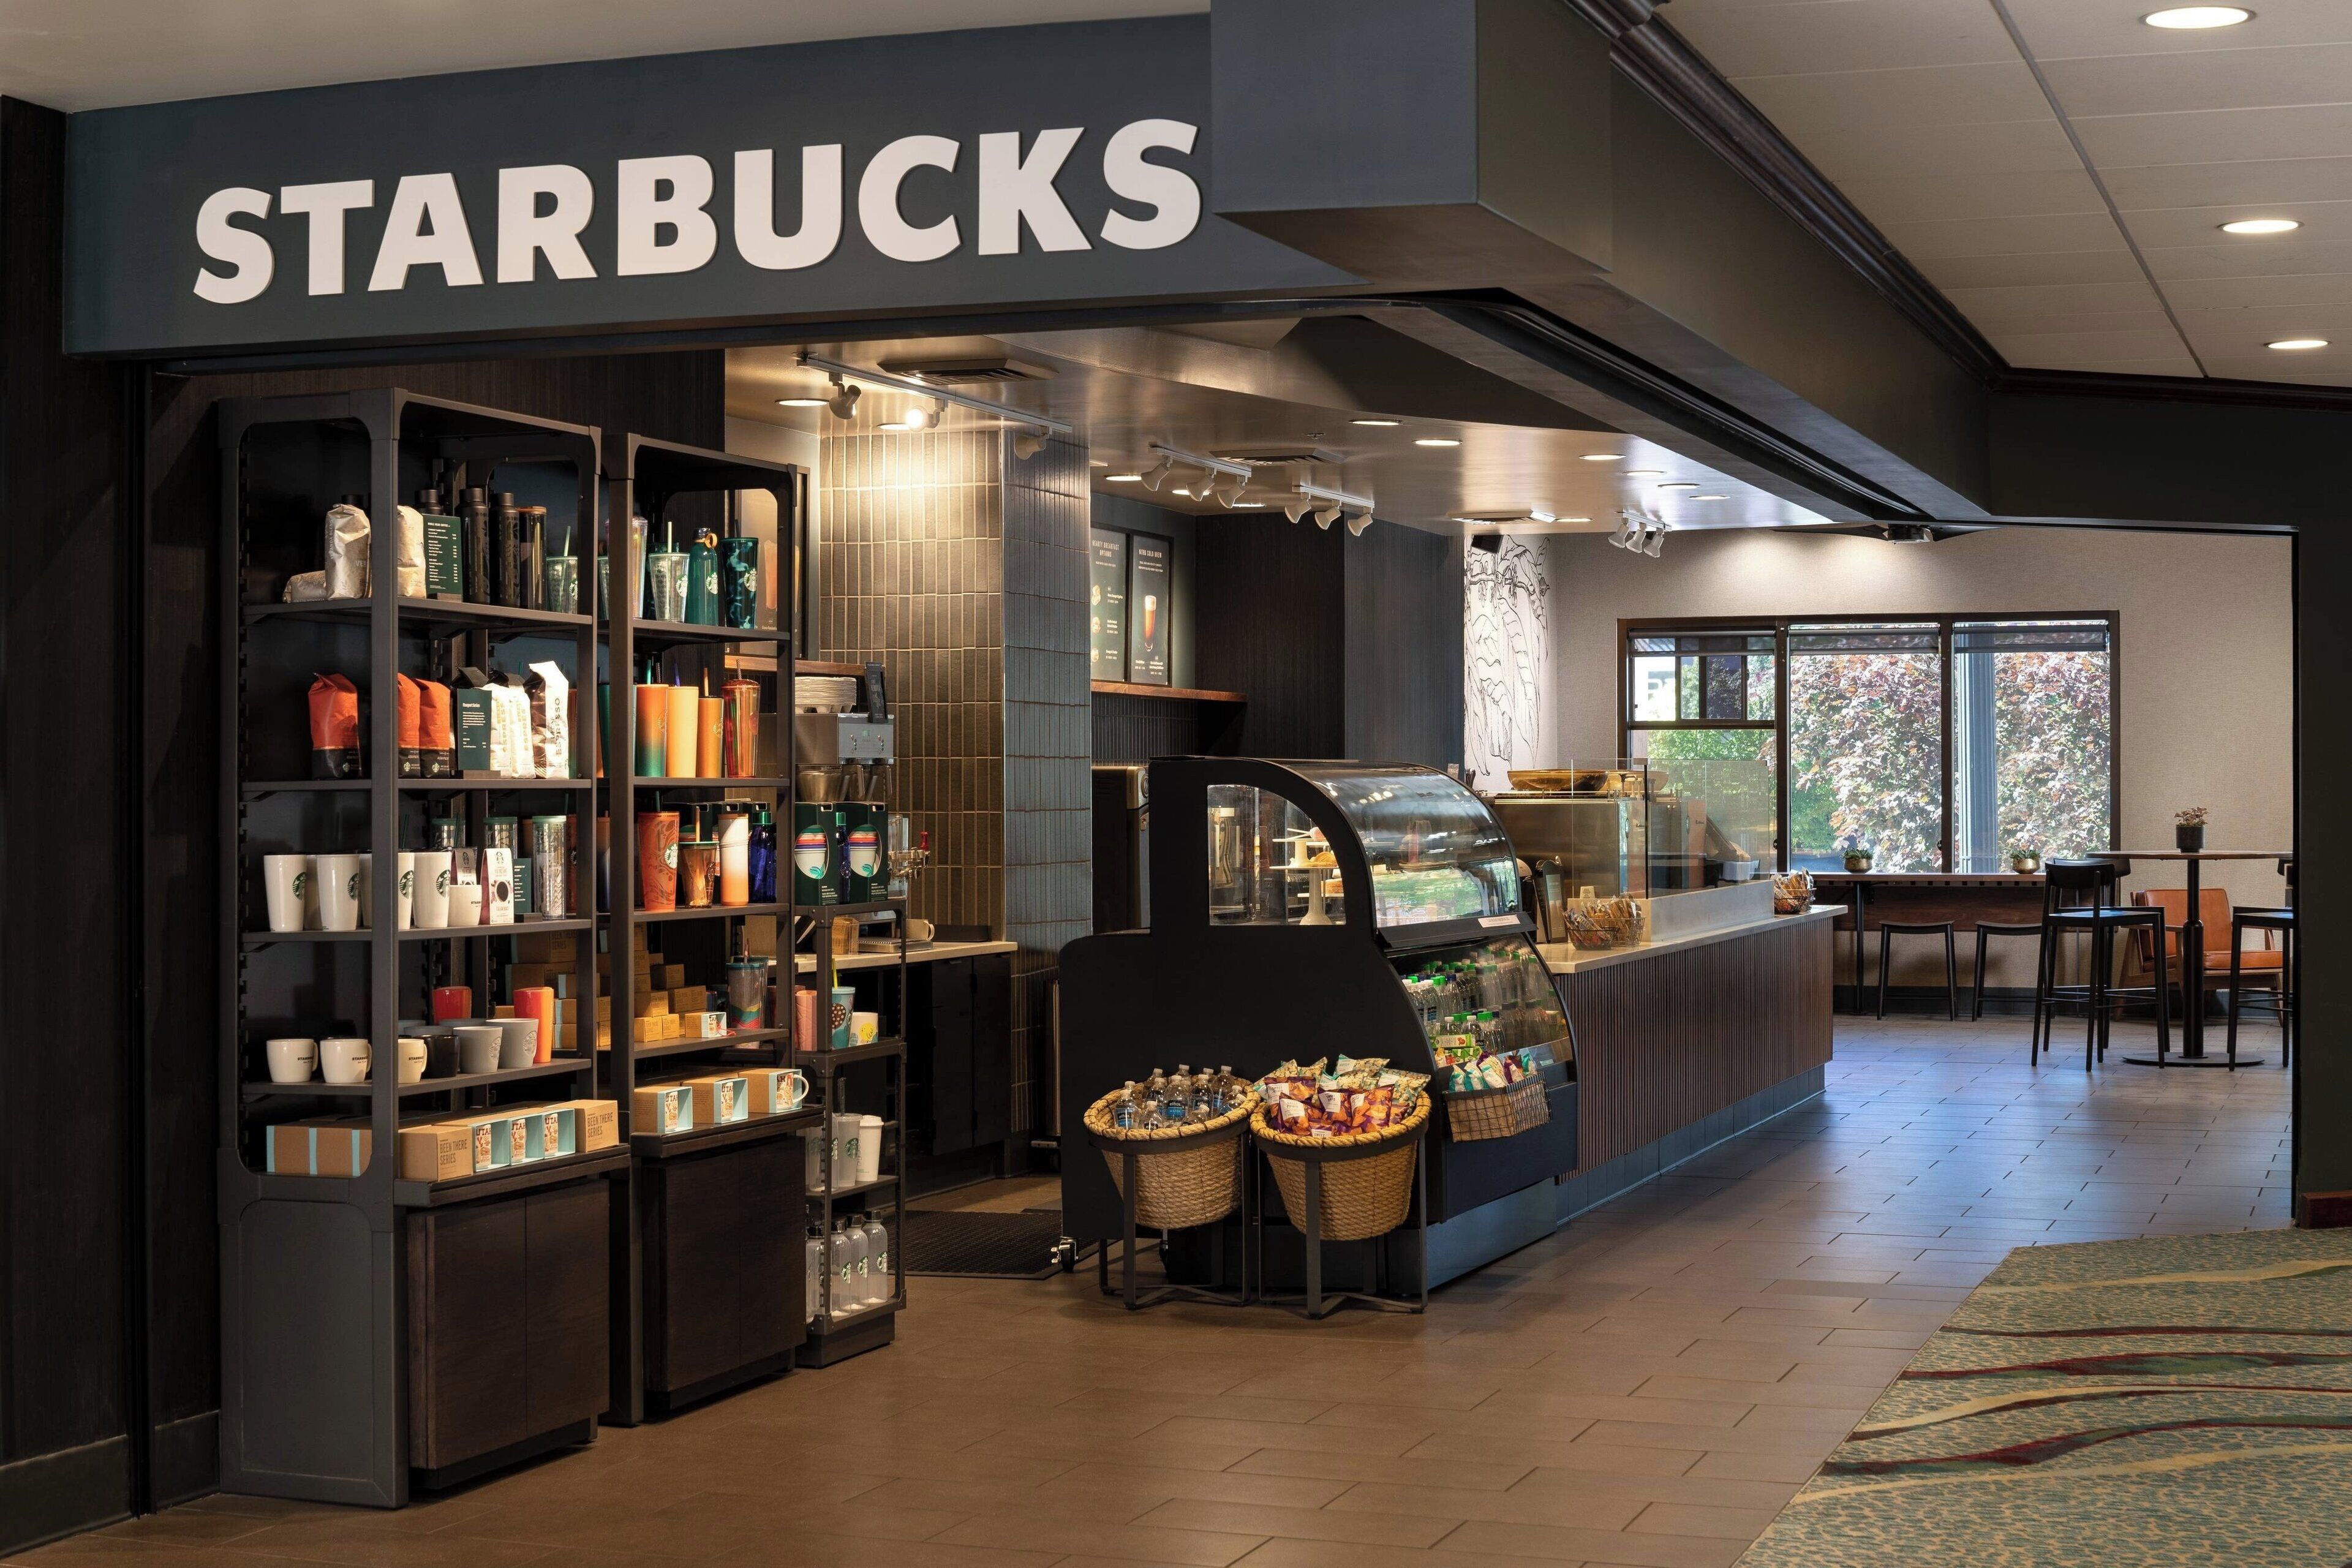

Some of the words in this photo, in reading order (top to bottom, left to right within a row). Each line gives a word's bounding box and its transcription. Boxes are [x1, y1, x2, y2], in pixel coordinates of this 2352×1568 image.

[194, 119, 1200, 304] STARBUCKS
[587, 1115, 599, 1127] BEEN
[600, 1112, 614, 1125] THERE
[587, 1126, 603, 1138] SERIES
[439, 1142, 452, 1154] BEEN
[453, 1139, 468, 1152] THERE
[440, 1152, 456, 1166] SERIES
